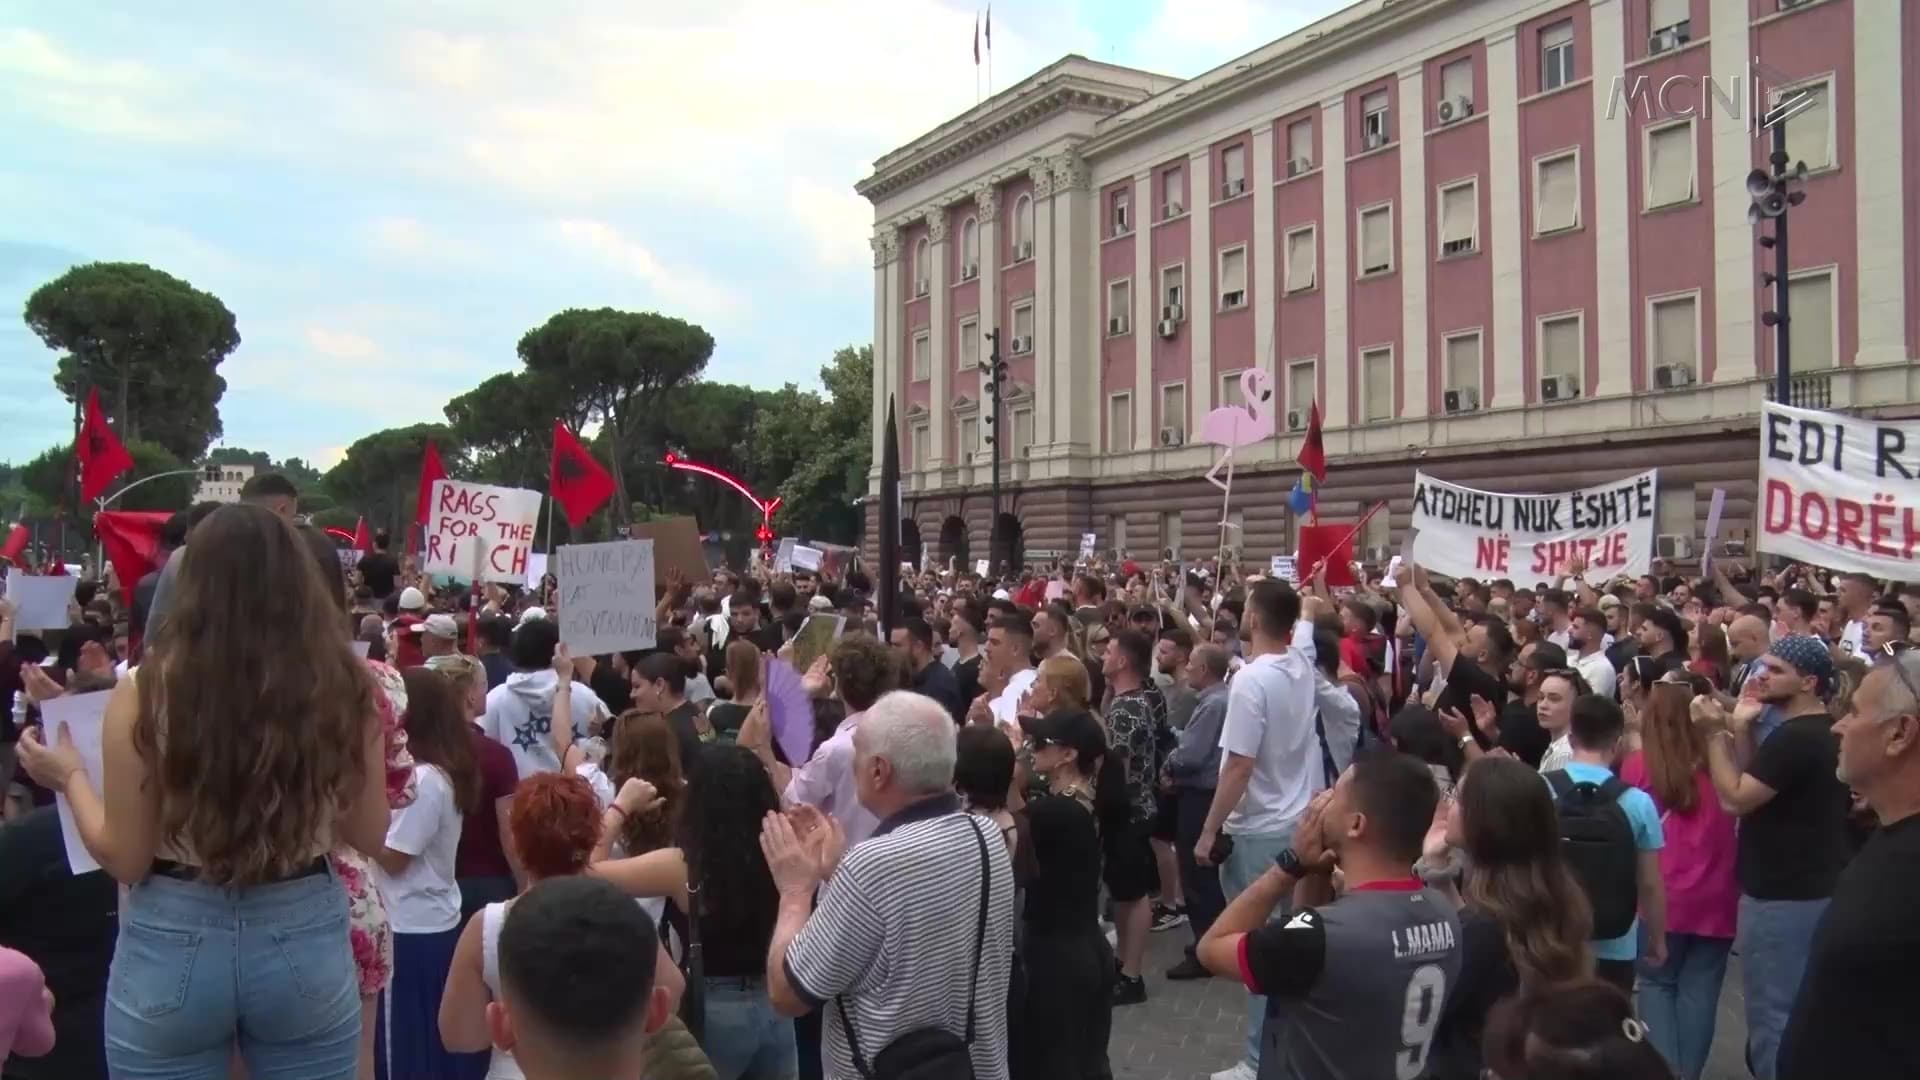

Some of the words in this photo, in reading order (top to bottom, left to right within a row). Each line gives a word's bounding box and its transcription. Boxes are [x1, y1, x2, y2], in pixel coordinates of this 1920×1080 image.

[1767, 412, 1845, 472] EDI
[1875, 426, 1920, 480] R
[440, 484, 500, 522] RAGS
[1412, 483, 1504, 531] ATDHEU
[1514, 497, 1563, 533] NUK
[1571, 476, 1653, 529] ËSHTË
[440, 516, 480, 538] FOR
[496, 522, 533, 541] THE
[1476, 532, 1511, 574] NË
[1392, 921, 1455, 959] L.MAMA
[1396, 964, 1446, 1080] 9
